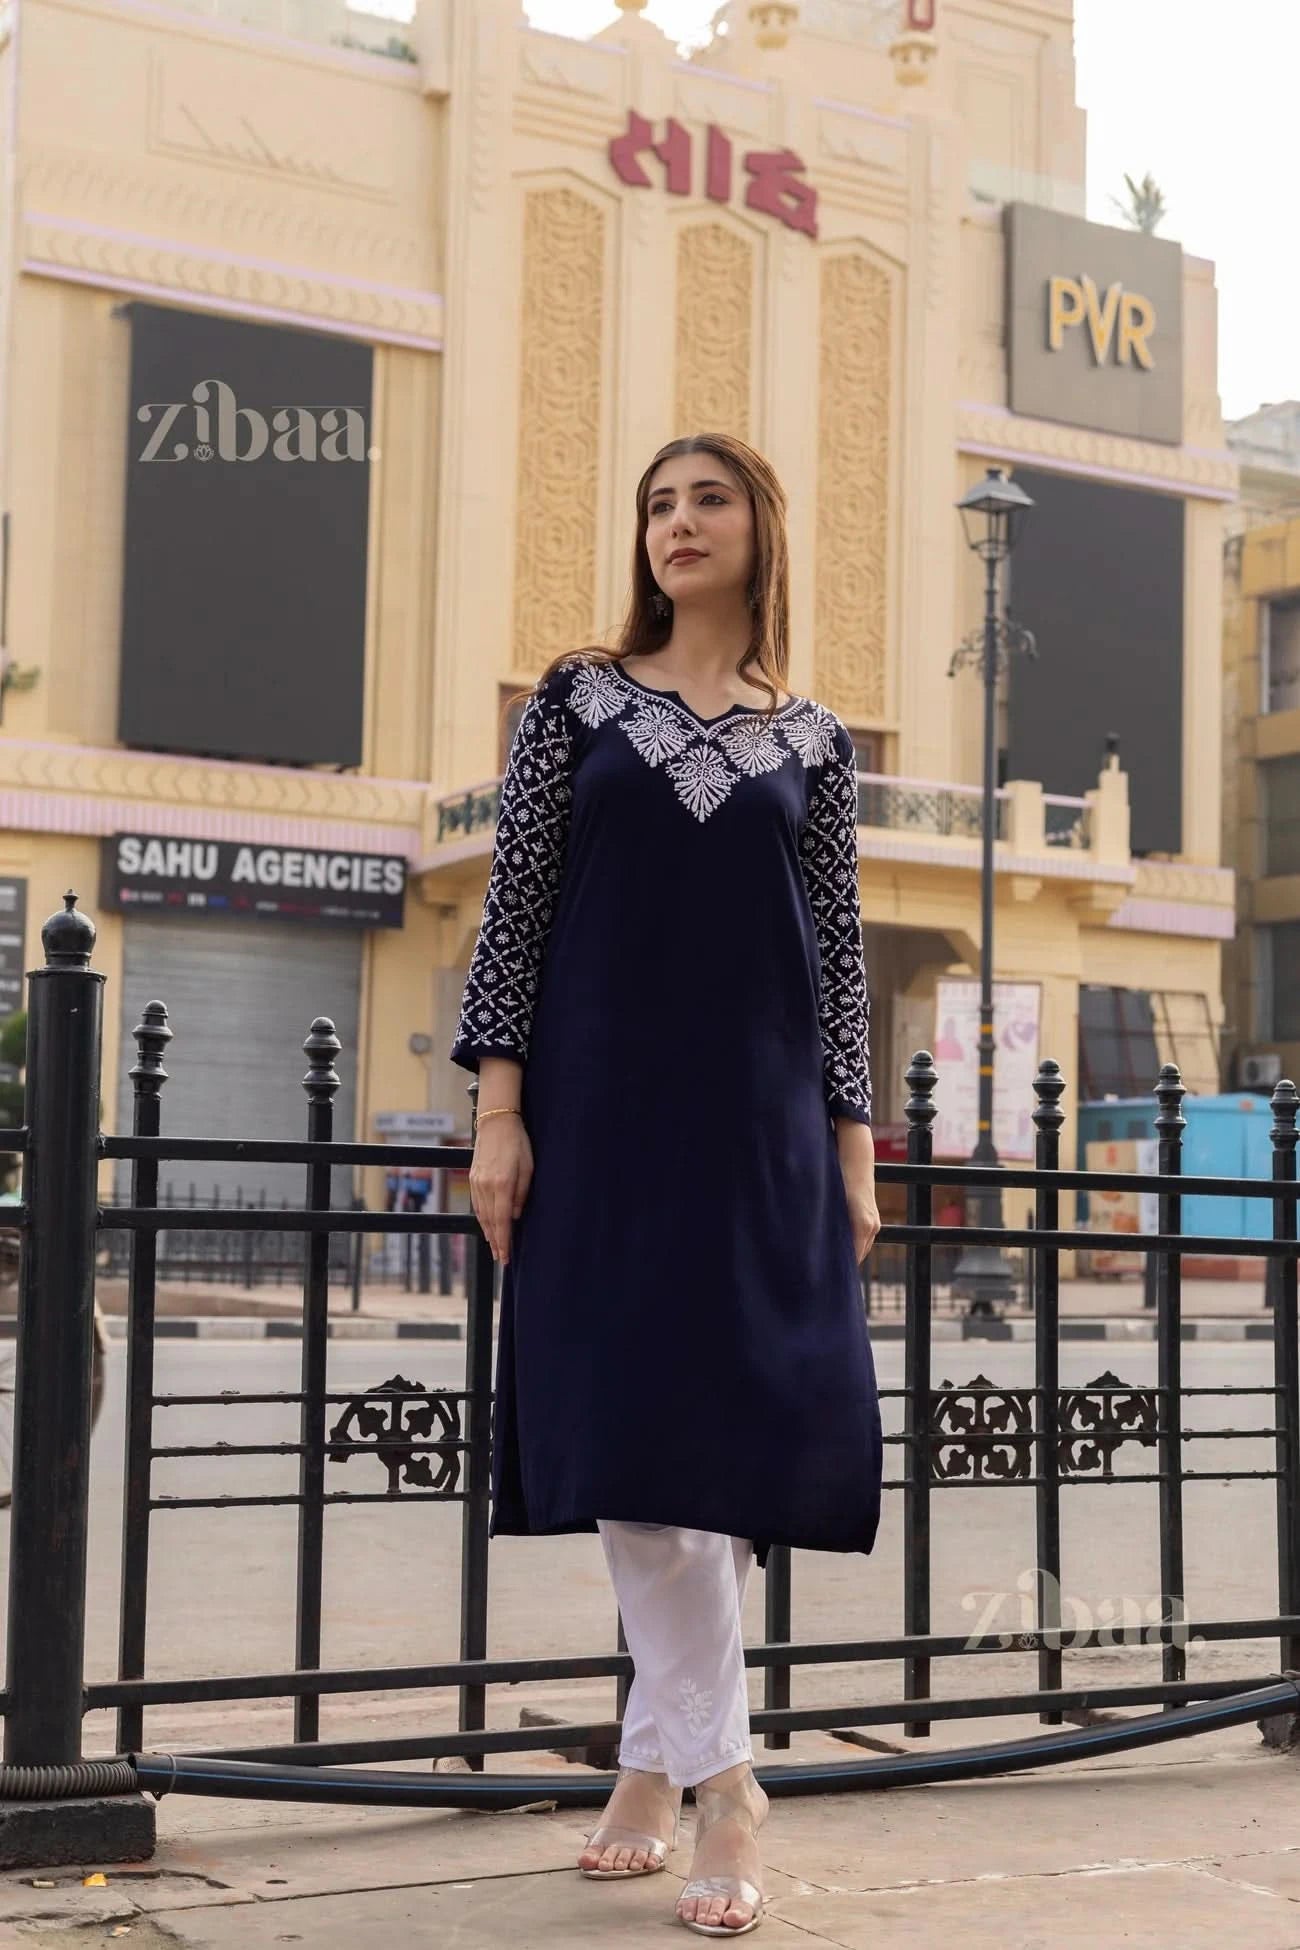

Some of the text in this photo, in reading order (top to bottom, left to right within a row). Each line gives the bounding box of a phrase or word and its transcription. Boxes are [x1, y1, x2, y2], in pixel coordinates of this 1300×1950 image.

[1048, 273, 1156, 369] PVR
[118, 838, 404, 894] SAHU AGENCIES
